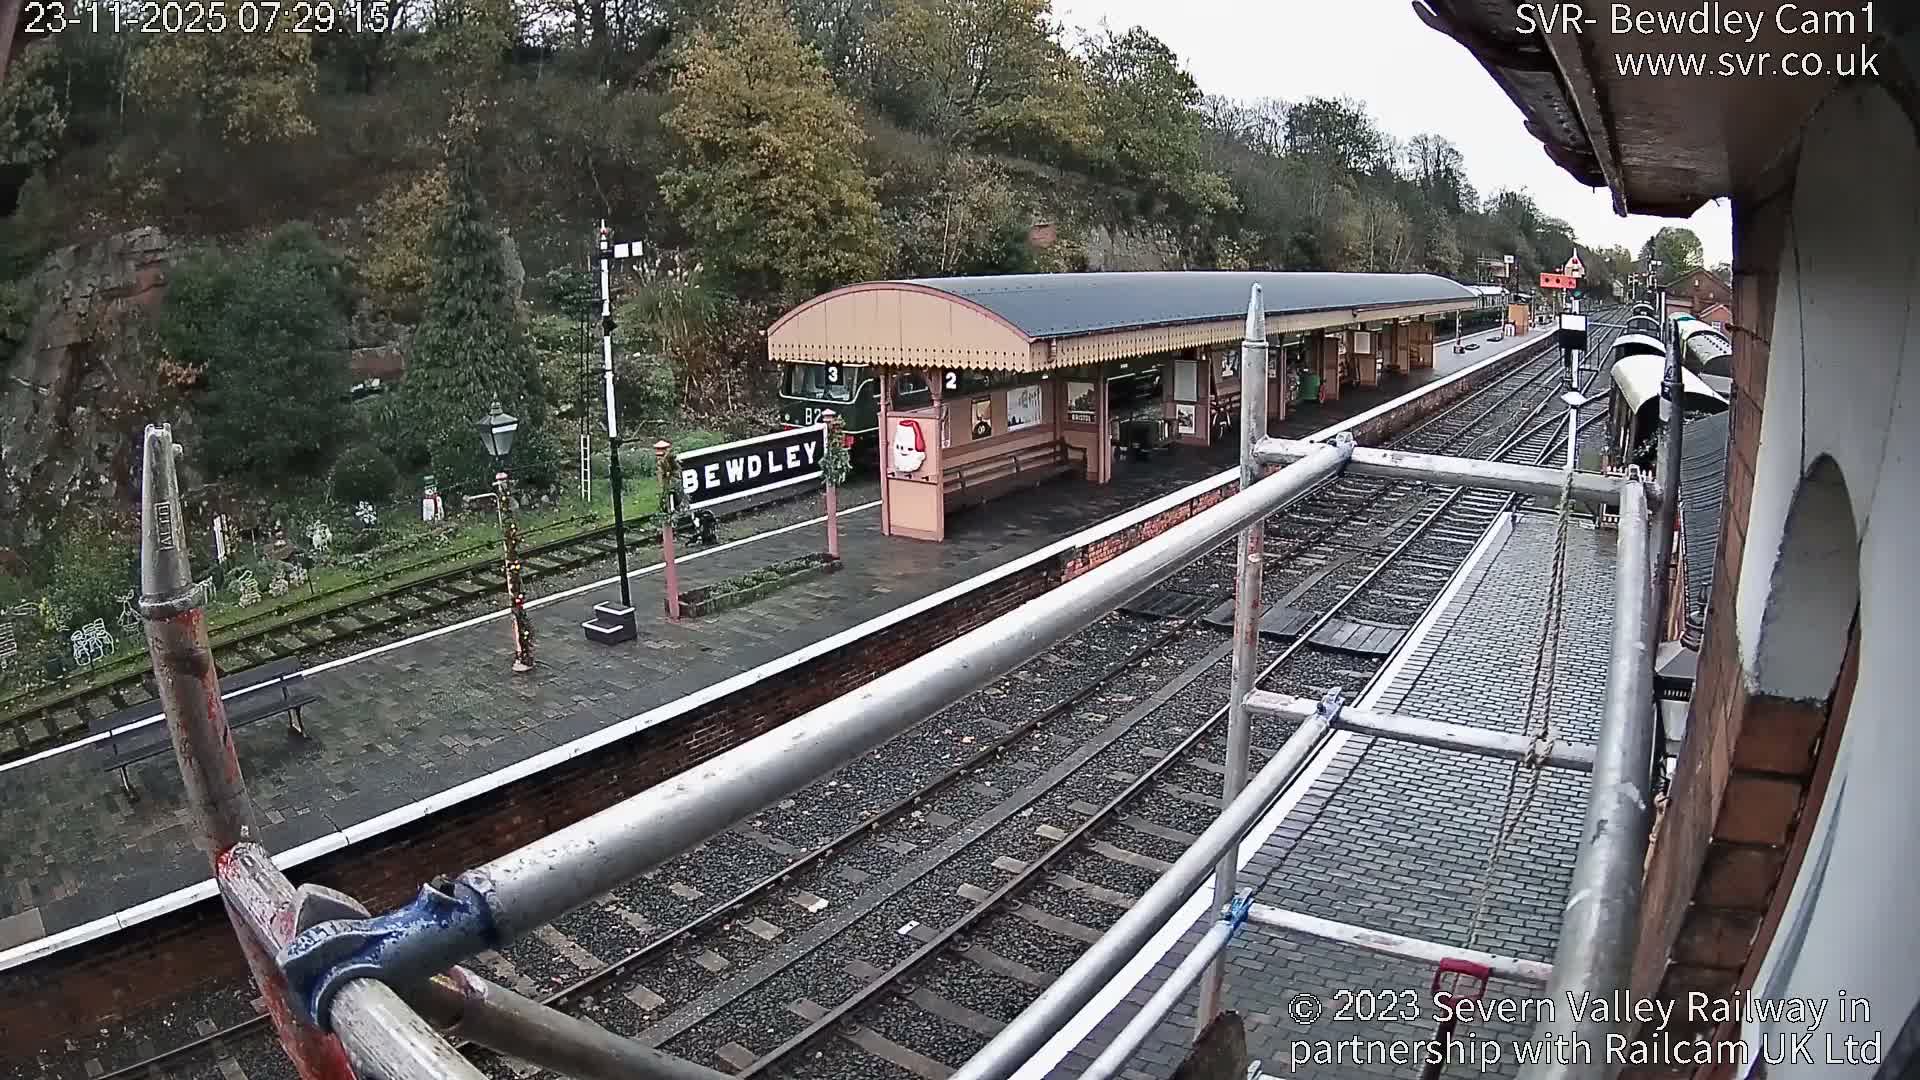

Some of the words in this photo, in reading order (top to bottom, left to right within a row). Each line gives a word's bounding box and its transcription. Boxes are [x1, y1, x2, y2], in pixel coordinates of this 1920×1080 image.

[828, 366, 839, 382] 3
[946, 372, 957, 389] 2
[682, 441, 817, 494] BEWDLEY
